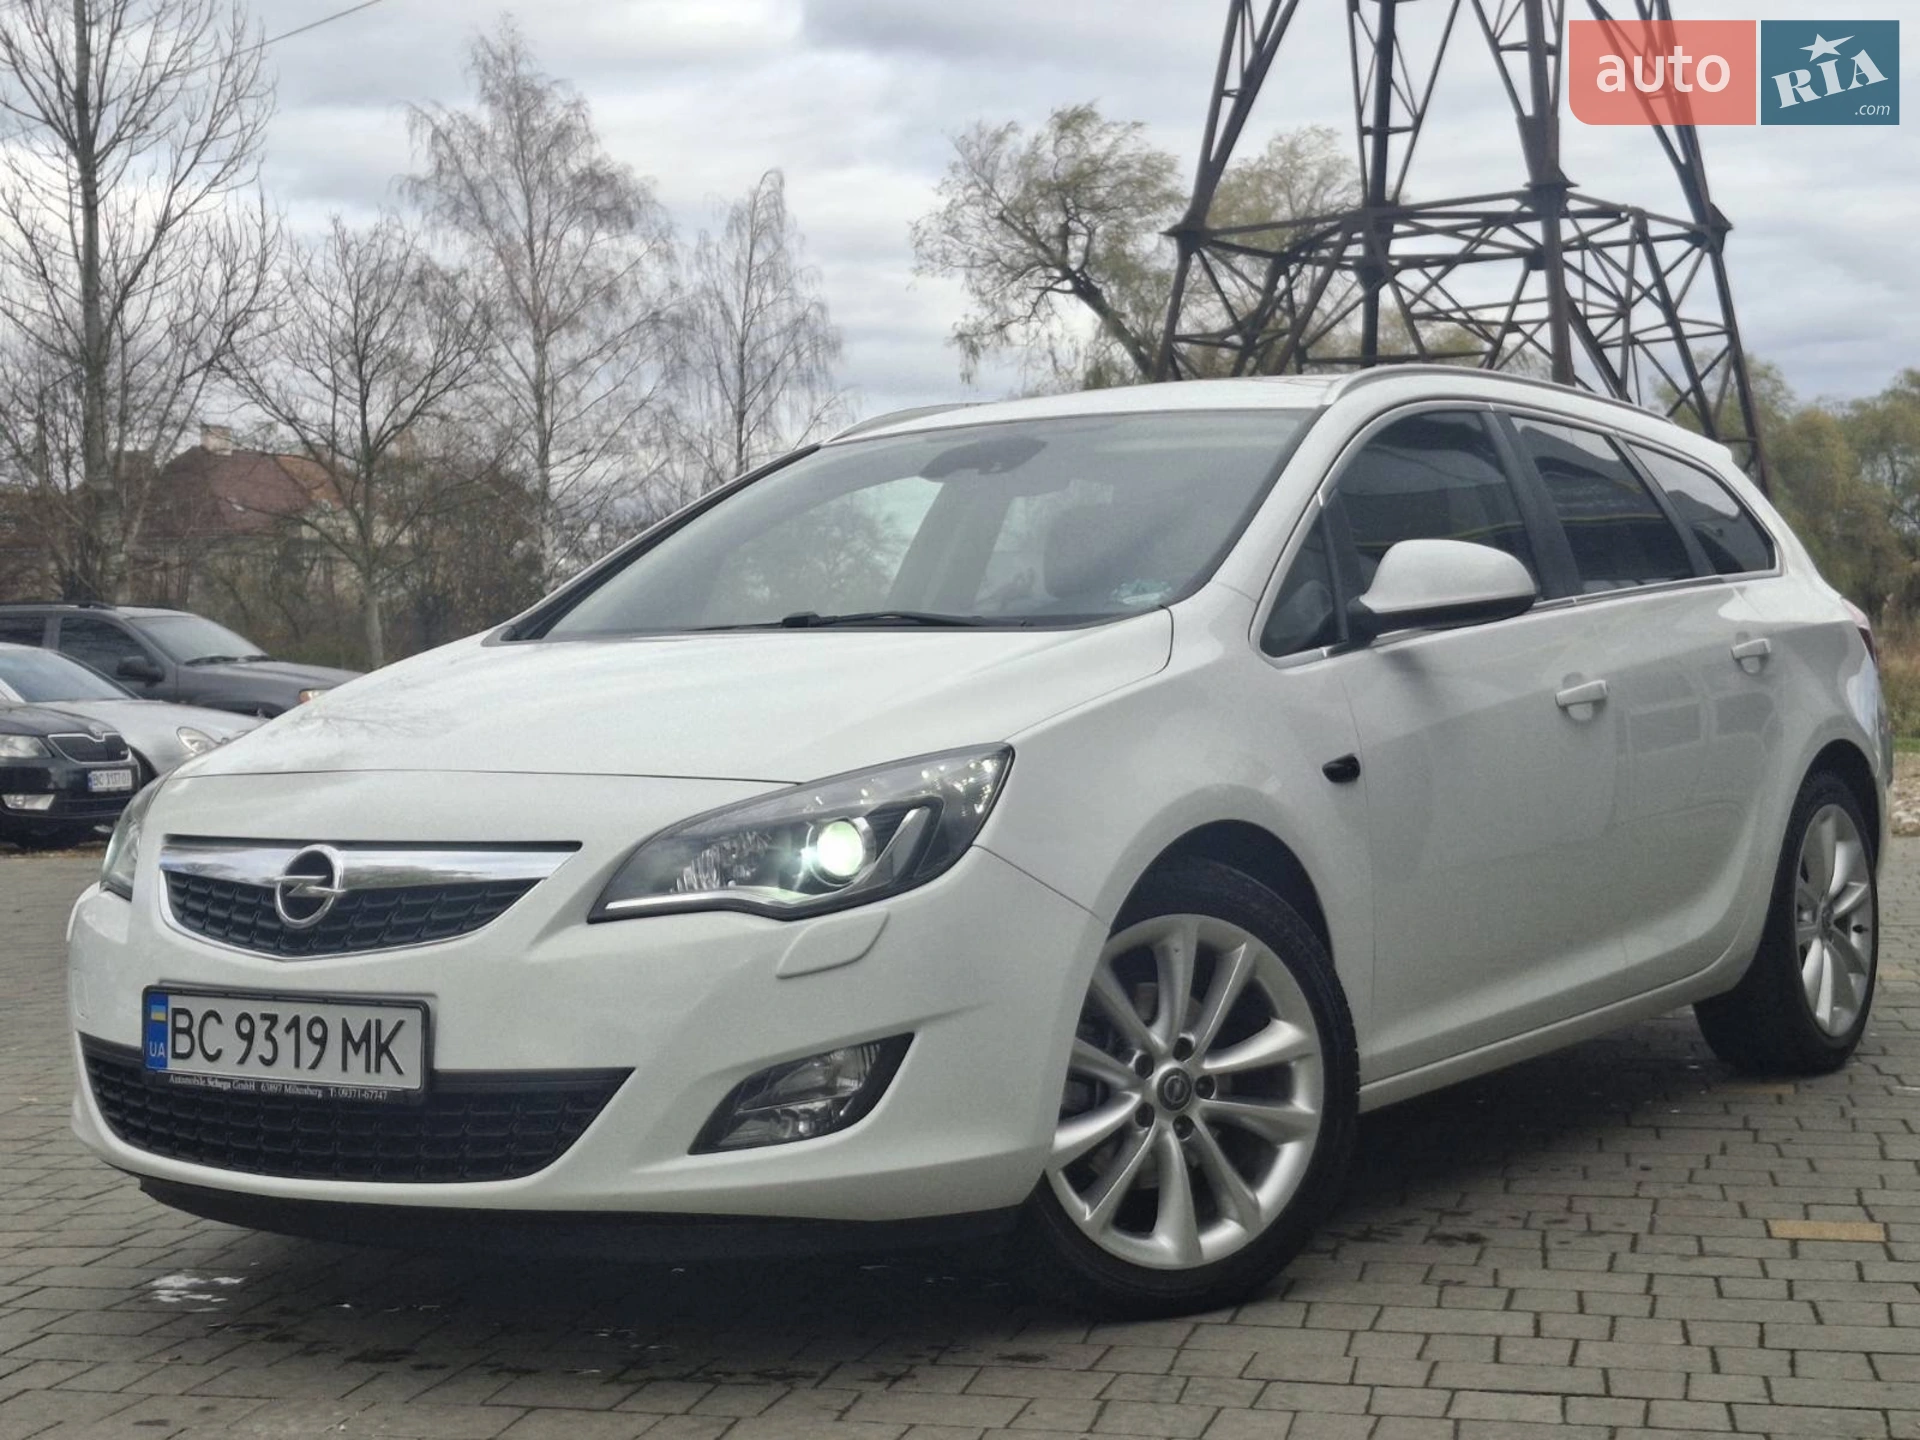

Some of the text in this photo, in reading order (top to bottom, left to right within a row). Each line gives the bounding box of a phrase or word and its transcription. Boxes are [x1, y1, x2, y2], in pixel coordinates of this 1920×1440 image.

[171, 1007, 406, 1075] BC 9319 MK
[150, 1042, 166, 1058] UA
[232, 1080, 256, 1091] GmbH
